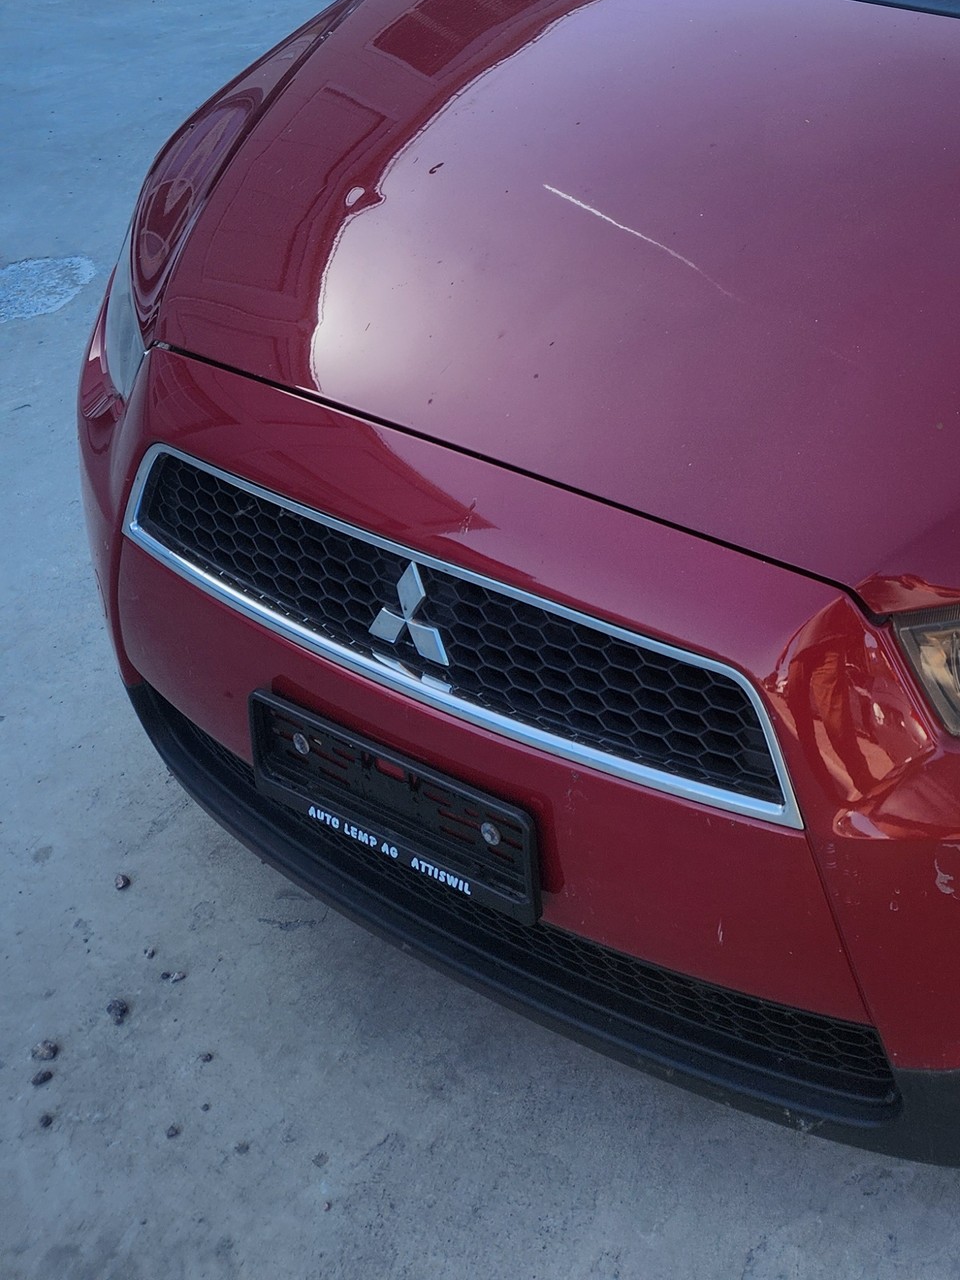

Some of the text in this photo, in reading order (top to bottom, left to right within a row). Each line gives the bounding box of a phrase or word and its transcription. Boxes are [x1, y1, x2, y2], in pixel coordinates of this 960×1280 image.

[308, 806, 472, 895] AUTO LEMP AG ATTISWIL
